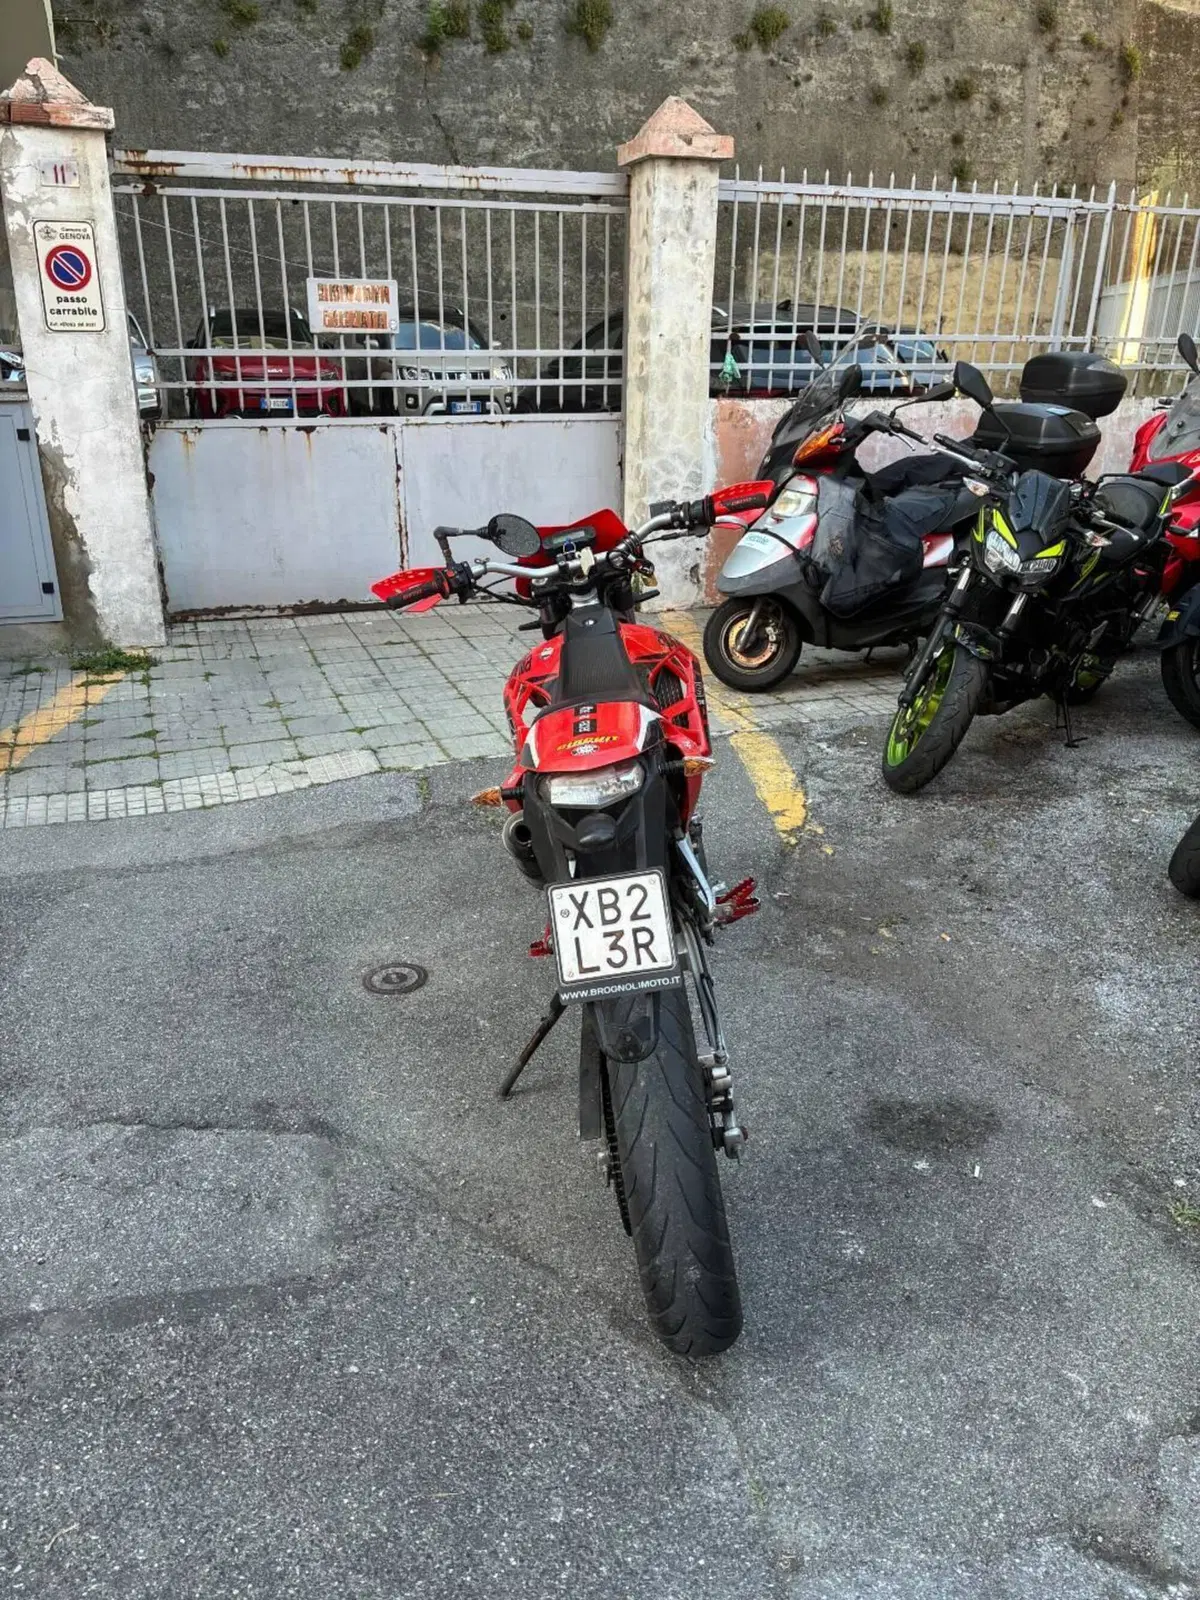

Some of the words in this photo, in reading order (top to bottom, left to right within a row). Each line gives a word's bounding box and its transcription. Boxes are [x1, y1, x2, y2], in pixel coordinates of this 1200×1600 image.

[53, 164, 66, 184] 11
[59, 232, 91, 240] GENOVA
[56, 295, 88, 305] passo
[49, 306, 98, 317] carrabile
[568, 883, 652, 931] XB2
[574, 926, 658, 974] L3R
[560, 975, 680, 1000] WWW.BROGNOLIMOTO.IT
